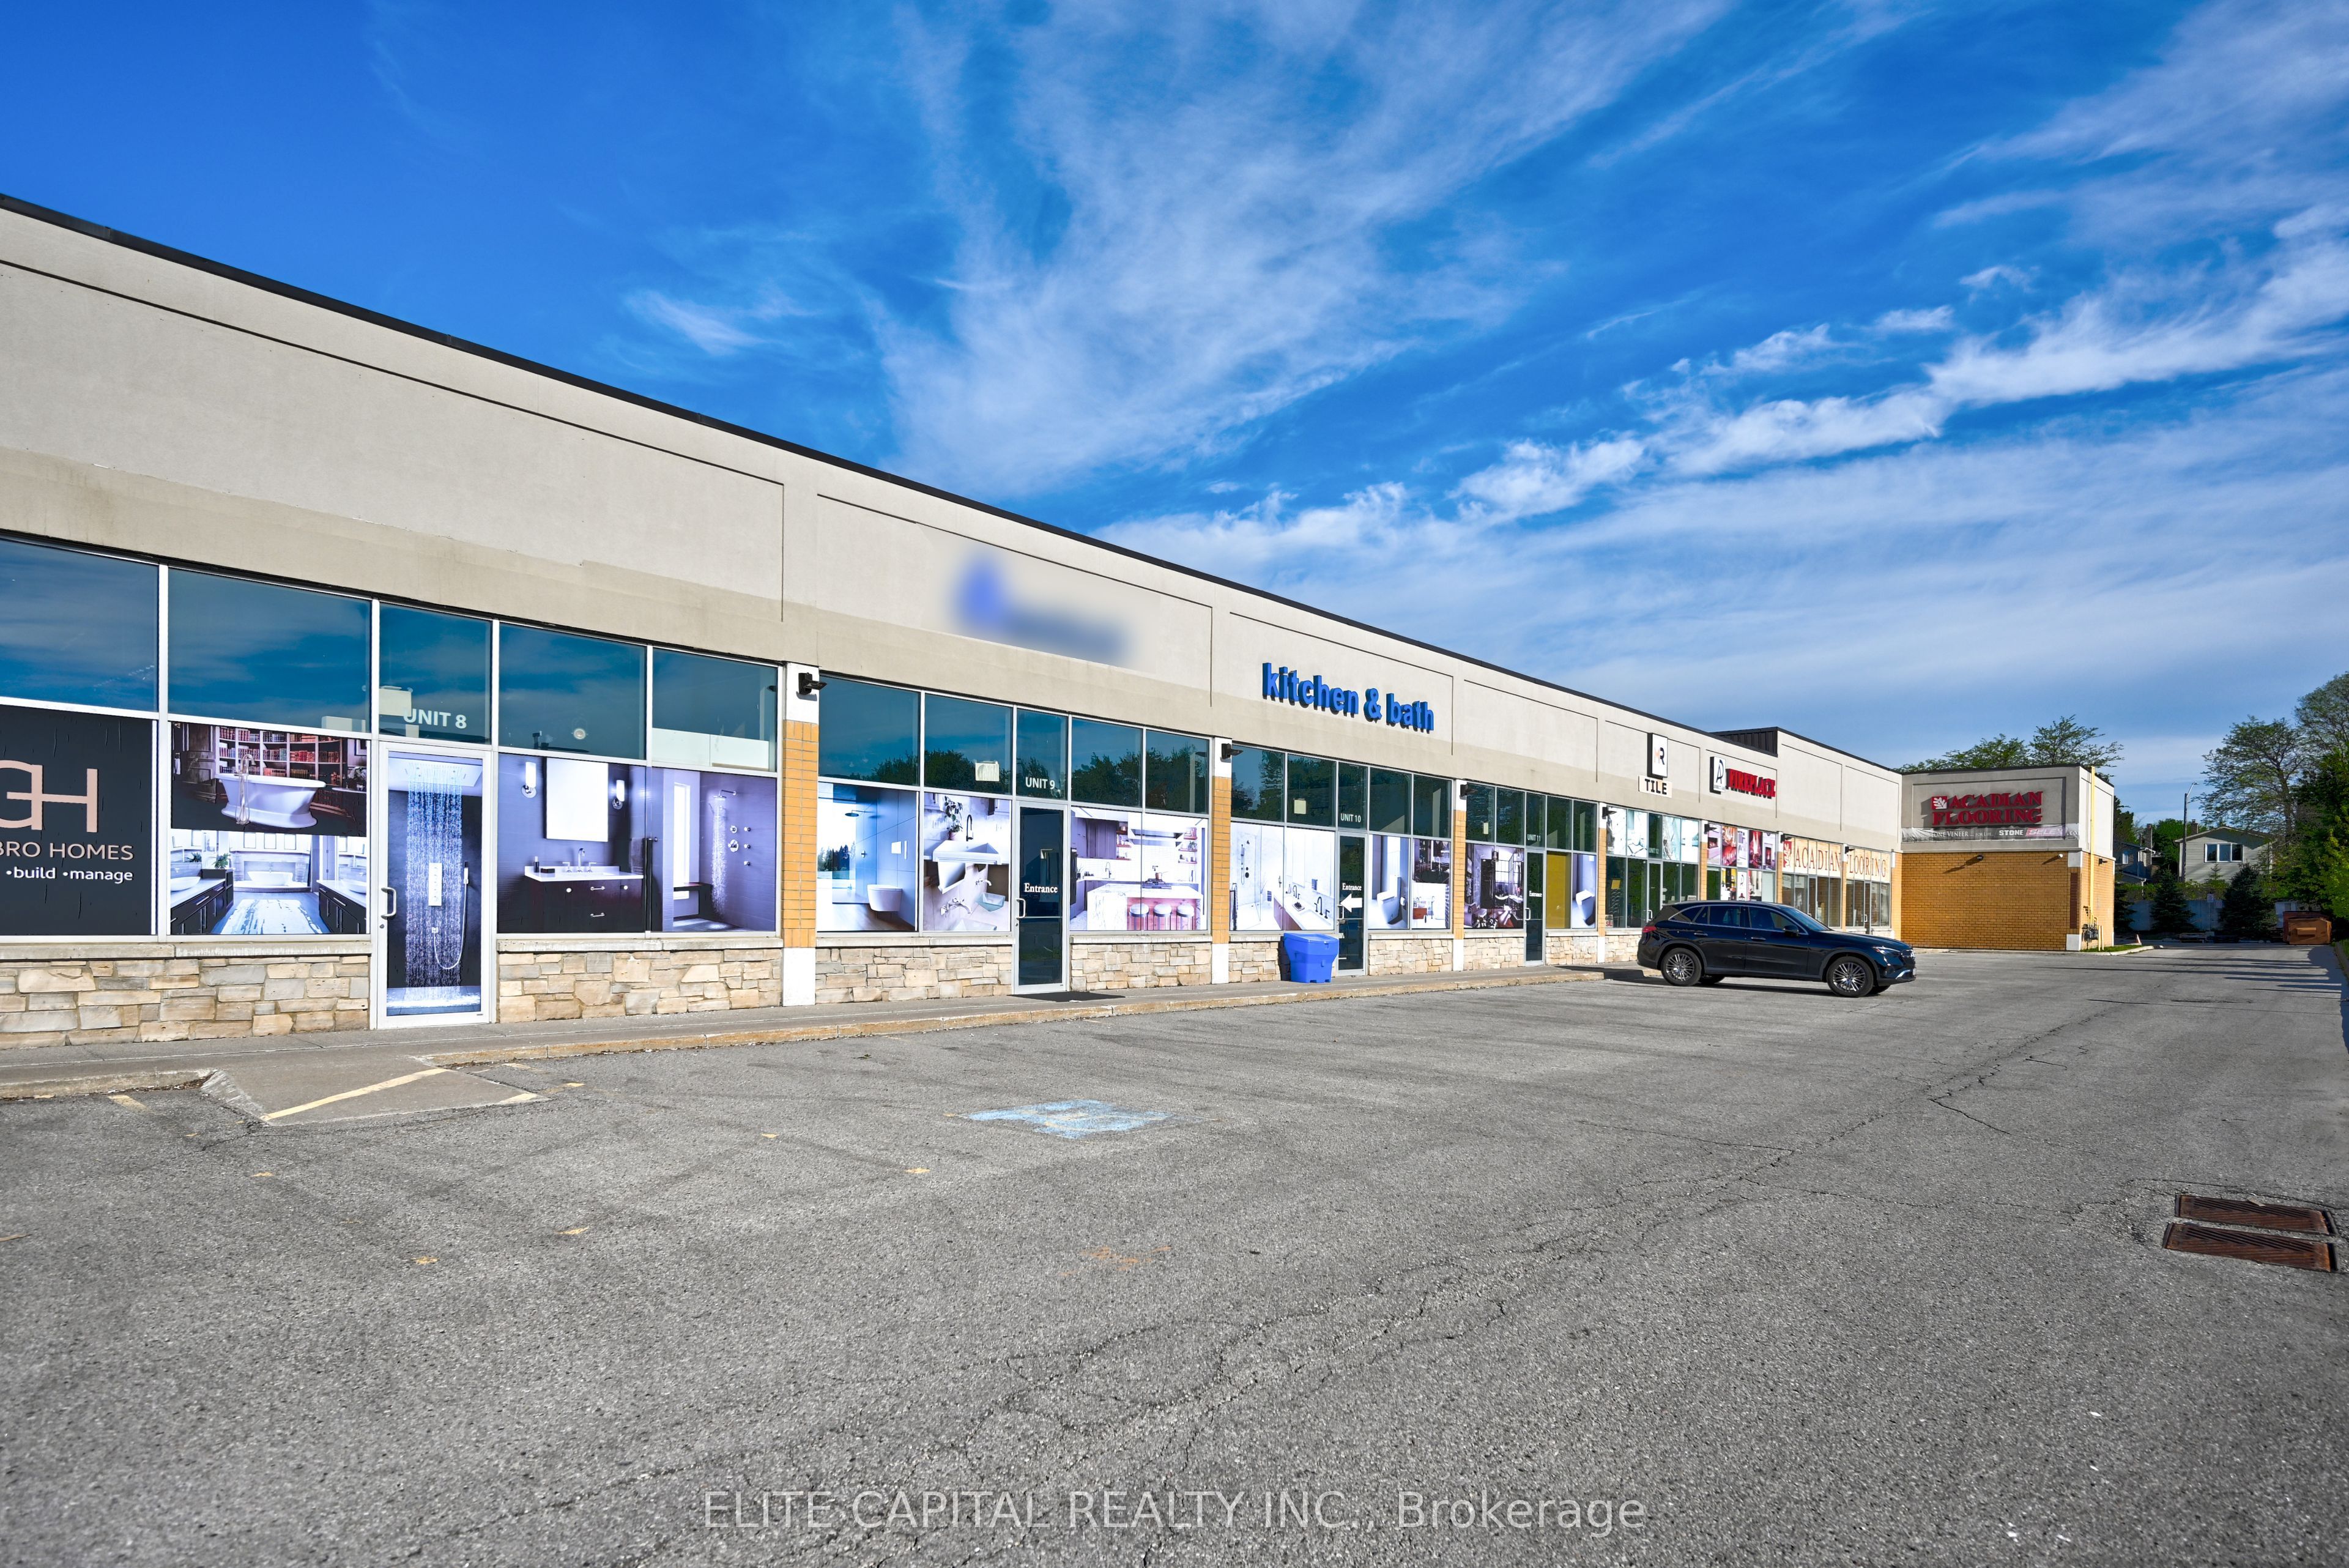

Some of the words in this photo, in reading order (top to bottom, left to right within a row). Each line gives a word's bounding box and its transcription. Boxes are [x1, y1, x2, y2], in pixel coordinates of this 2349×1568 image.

[1262, 662, 1359, 715] kitchen
[1363, 688, 1382, 719] &
[1386, 693, 1434, 731] bath
[403, 708, 451, 727] UNIT
[455, 714, 467, 729] 8
[1025, 776, 1048, 789] UNIT
[1049, 779, 1055, 790] 9
[1644, 778, 1668, 795] TILE
[1949, 791, 2044, 809] ACADIAN
[1340, 813, 1354, 822] UNIT
[1932, 808, 2043, 825] FLOORING
[50, 842, 135, 861] HOMES
[1795, 847, 1841, 872] ACADIAN
[1024, 883, 1058, 893] Entrance
